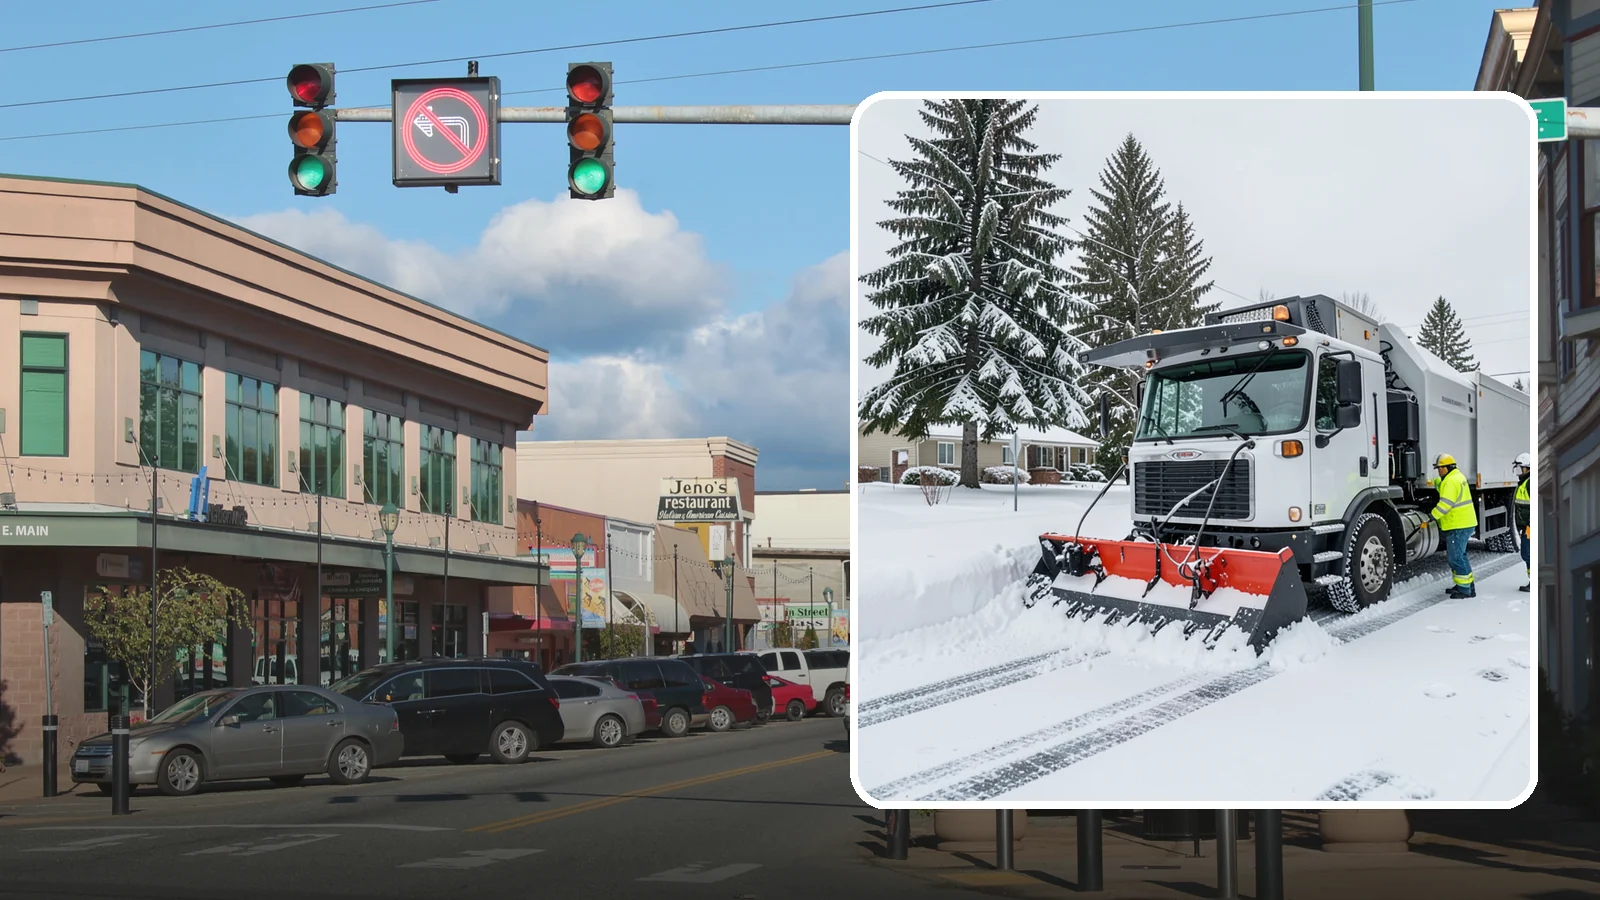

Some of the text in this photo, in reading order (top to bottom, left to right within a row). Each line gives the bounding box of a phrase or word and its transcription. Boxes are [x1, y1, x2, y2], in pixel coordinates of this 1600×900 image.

[669, 480, 728, 495] Jeno's
[664, 496, 731, 509] restaurant
[714, 509, 738, 520] Cuisine
[2, 525, 49, 536] E. MAIN
[797, 607, 828, 617] Street
